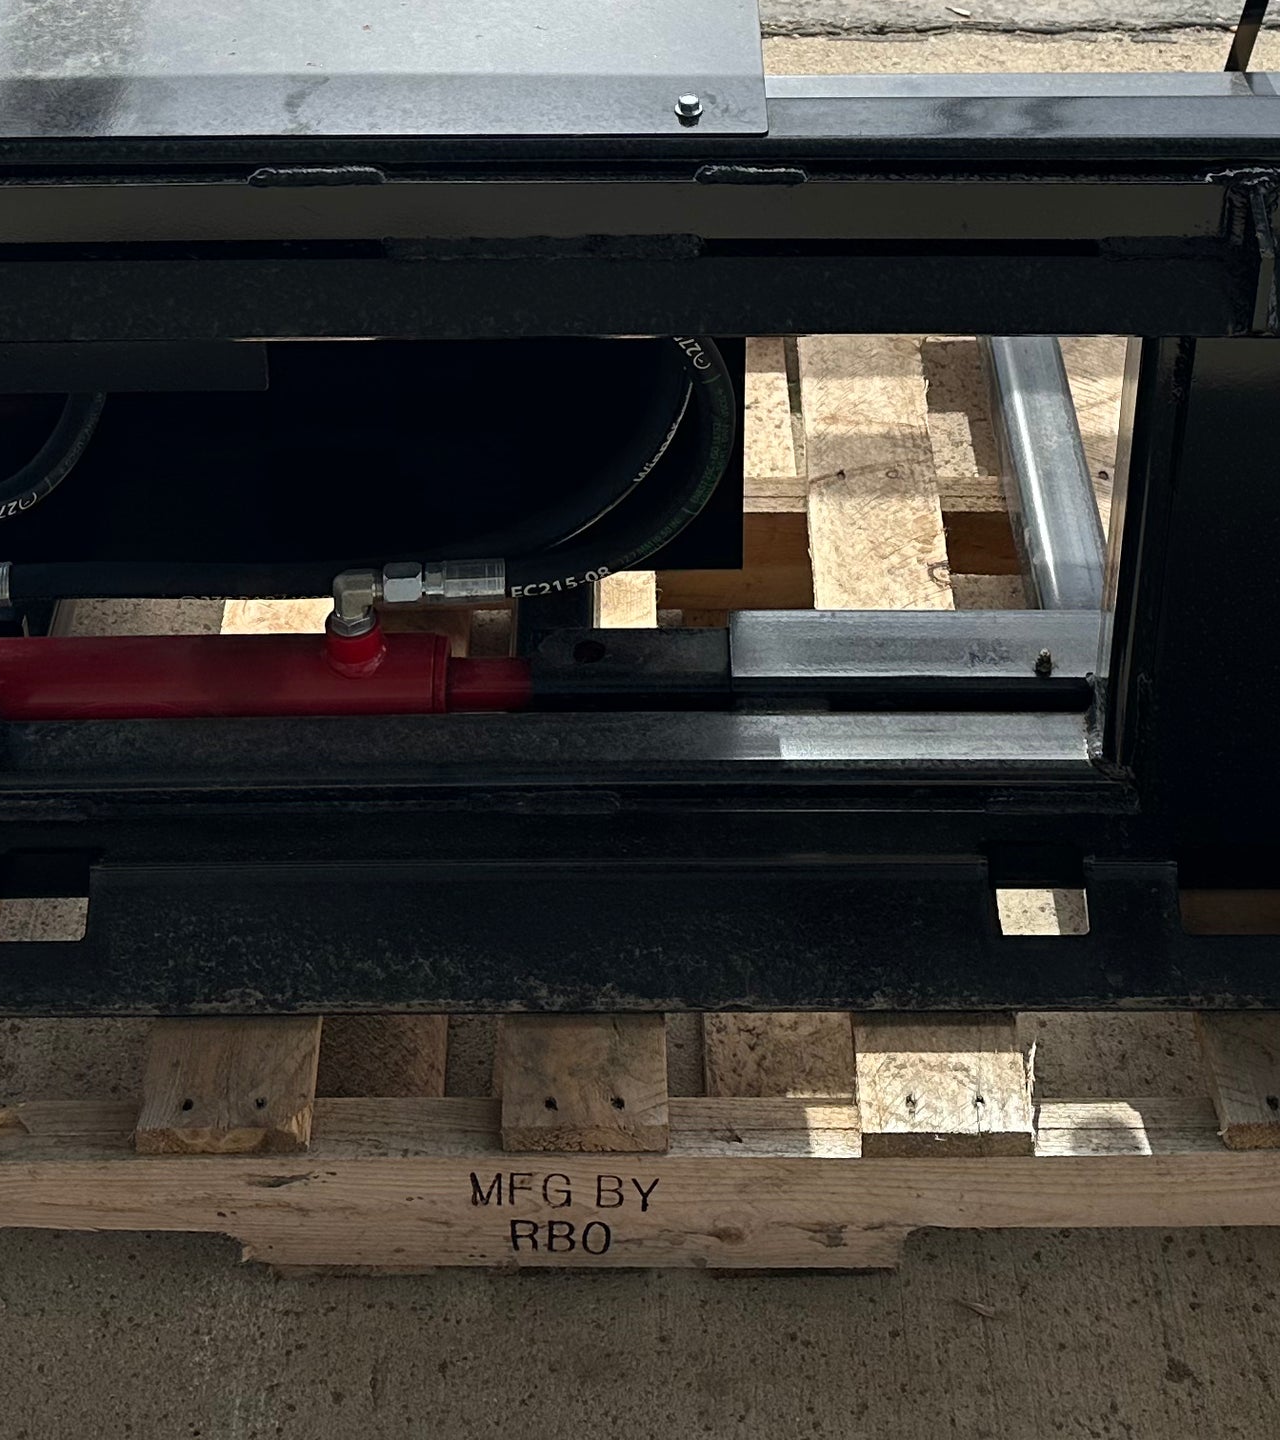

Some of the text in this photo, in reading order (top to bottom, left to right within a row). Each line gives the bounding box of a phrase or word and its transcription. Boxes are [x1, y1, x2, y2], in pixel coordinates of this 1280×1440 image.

[510, 565, 612, 598] EC215-08
[469, 1172, 660, 1212] MFG BY
[509, 1219, 612, 1255] RBO
